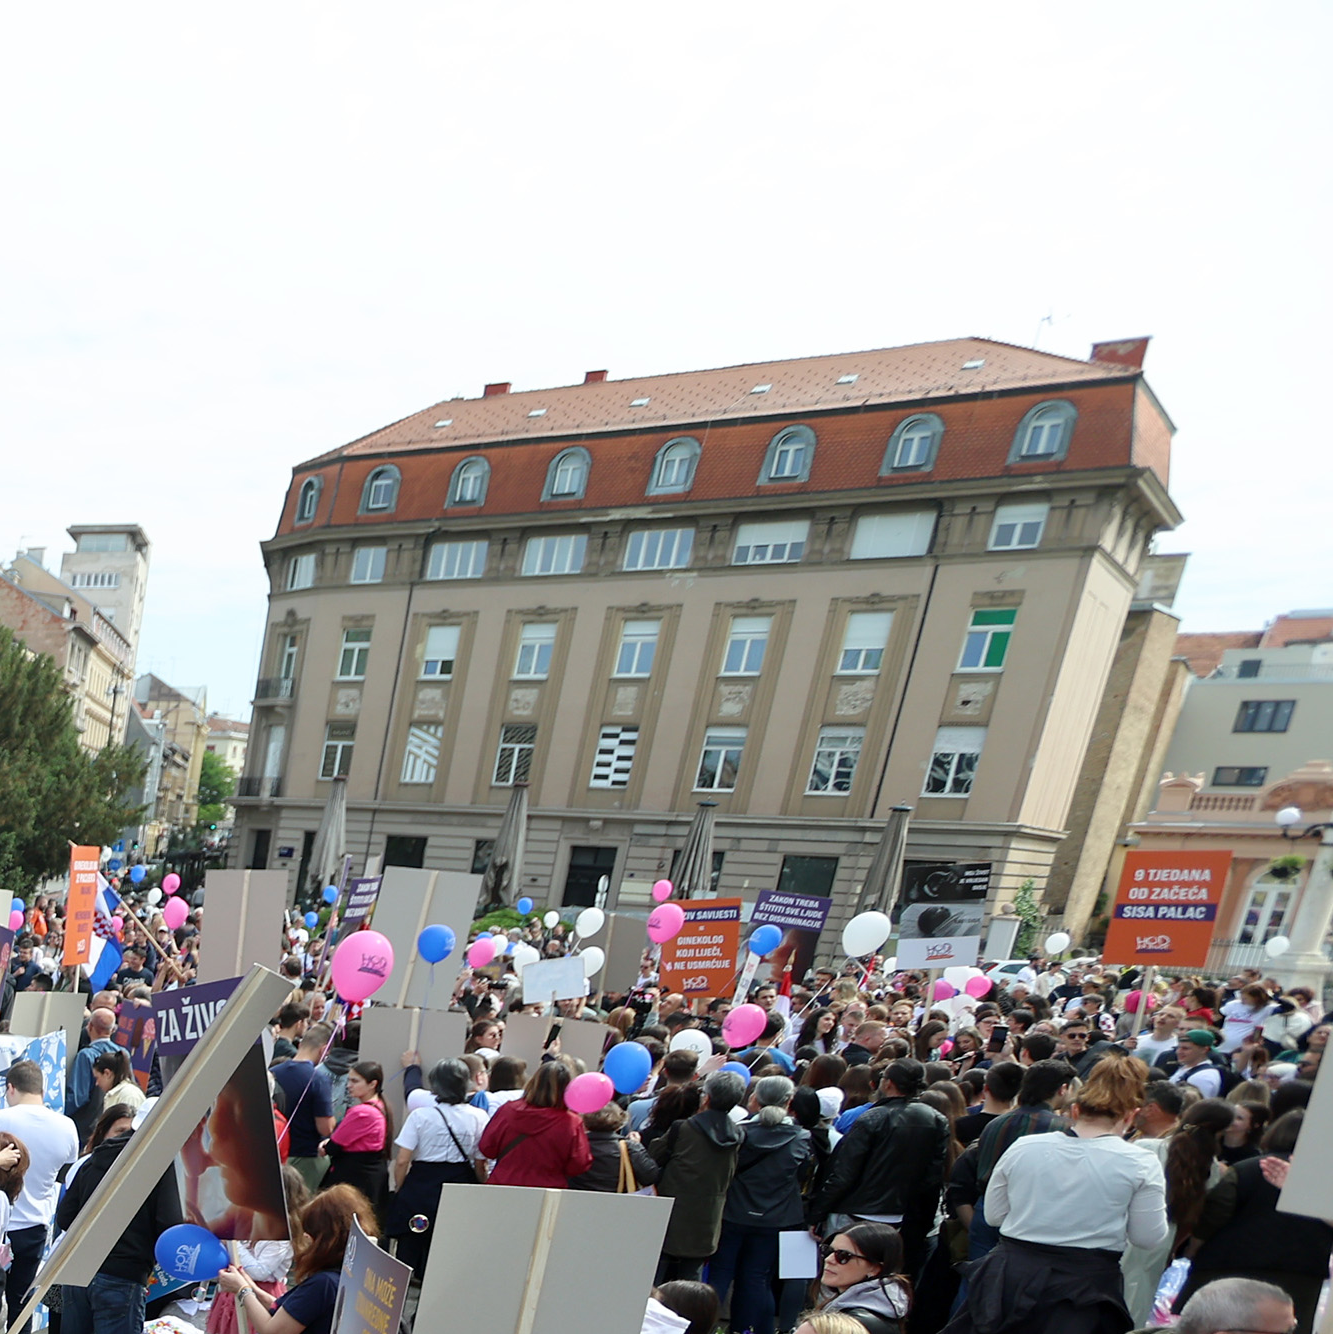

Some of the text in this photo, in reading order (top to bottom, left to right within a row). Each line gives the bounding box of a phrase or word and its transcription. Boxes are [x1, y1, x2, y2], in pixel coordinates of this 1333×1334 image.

[1134, 868, 1212, 883] 9 TJEDANA
[1128, 884, 1209, 901] OD ZAČEĆA
[768, 894, 820, 908] ZAKON TREBA
[696, 908, 738, 921] SAVIJESTI
[753, 912, 769, 921] BEZ
[758, 901, 824, 919] ŠTITITI SVE LJUDE
[1121, 905, 1207, 920] SISA PALAC
[676, 934, 725, 946] GINEKOLOG
[675, 947, 695, 958] KOJI
[673, 961, 686, 970] NE
[157, 1007, 182, 1044] ZA
